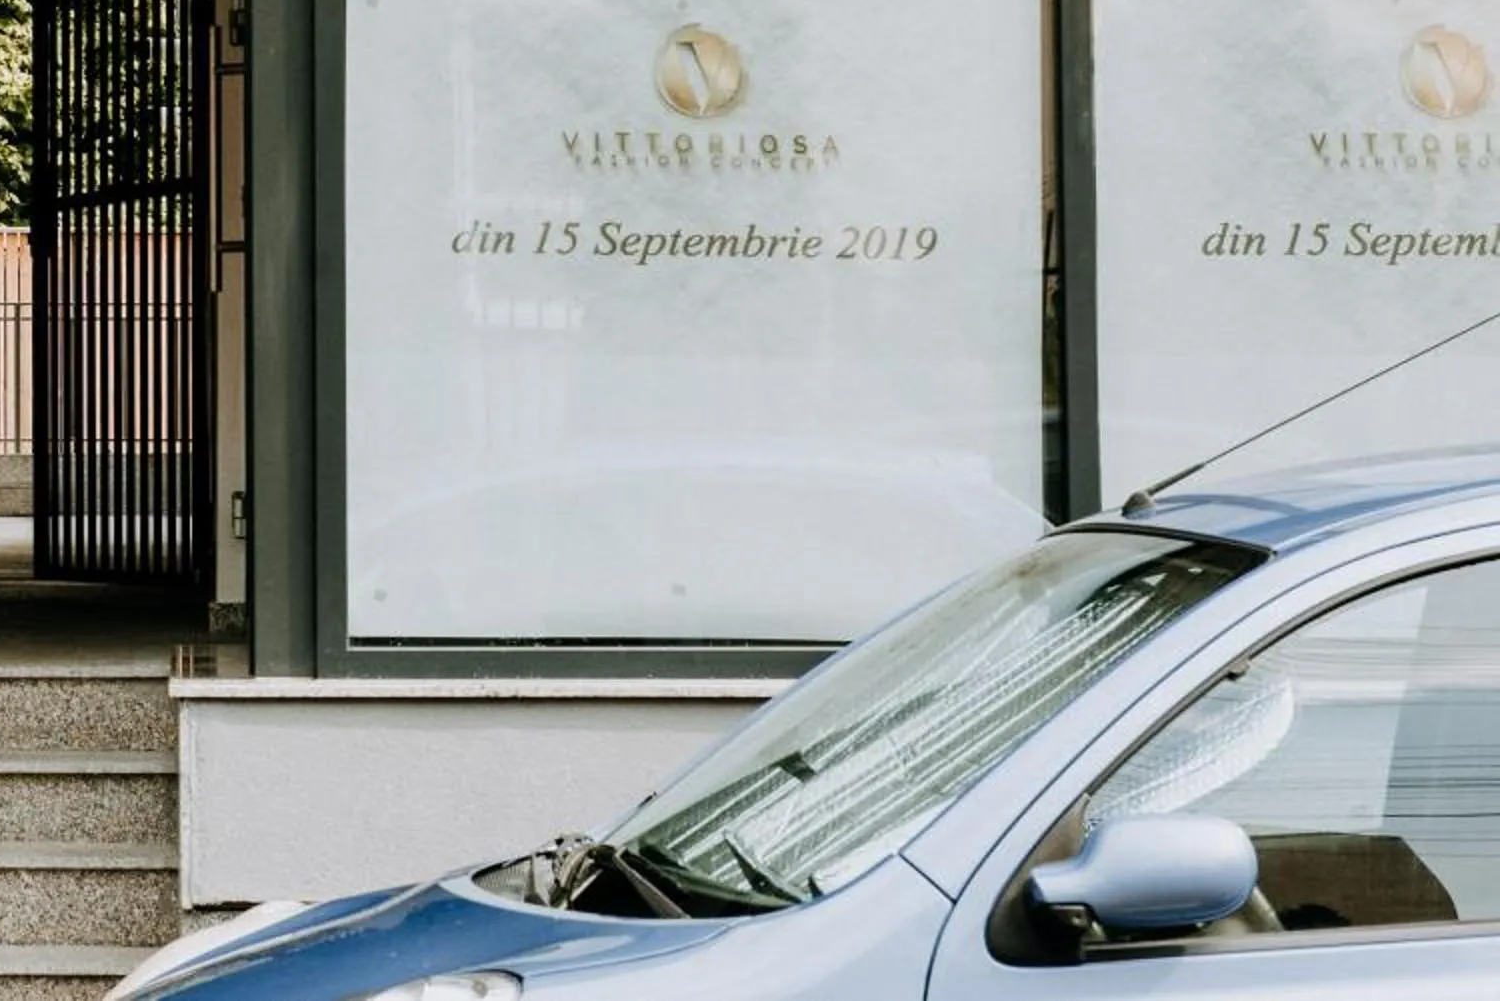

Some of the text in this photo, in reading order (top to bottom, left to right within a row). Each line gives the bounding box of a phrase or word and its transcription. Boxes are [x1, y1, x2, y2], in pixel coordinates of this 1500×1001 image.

[562, 130, 840, 157] VITTORIOSA
[451, 220, 938, 266] din 15 Septembrie 2019
[1201, 222, 1267, 257] din
[1283, 222, 1331, 256] 15
